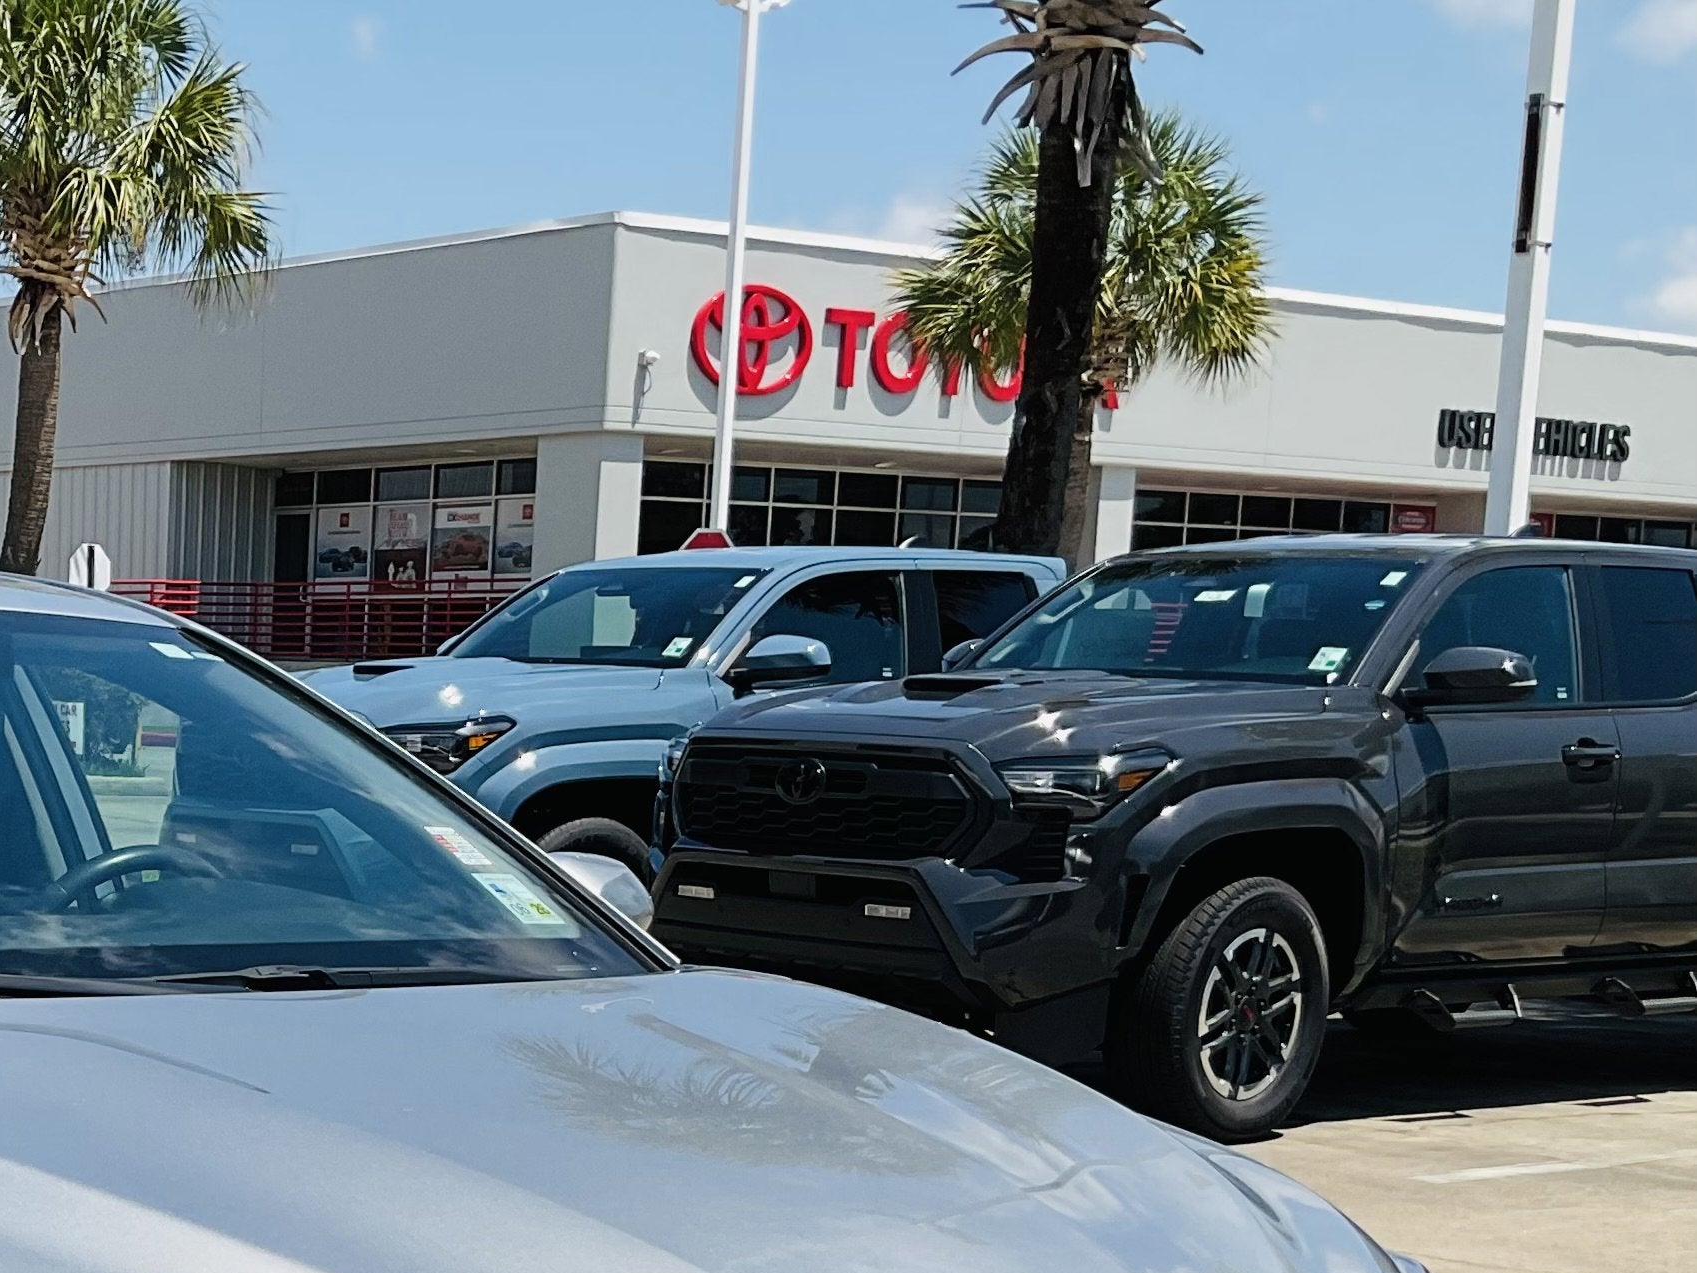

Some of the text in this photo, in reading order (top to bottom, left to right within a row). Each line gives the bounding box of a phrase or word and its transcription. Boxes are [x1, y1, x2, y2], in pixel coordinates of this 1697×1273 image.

[825, 307, 1119, 410] TOO
[1437, 408, 1631, 463] USE EHICLES
